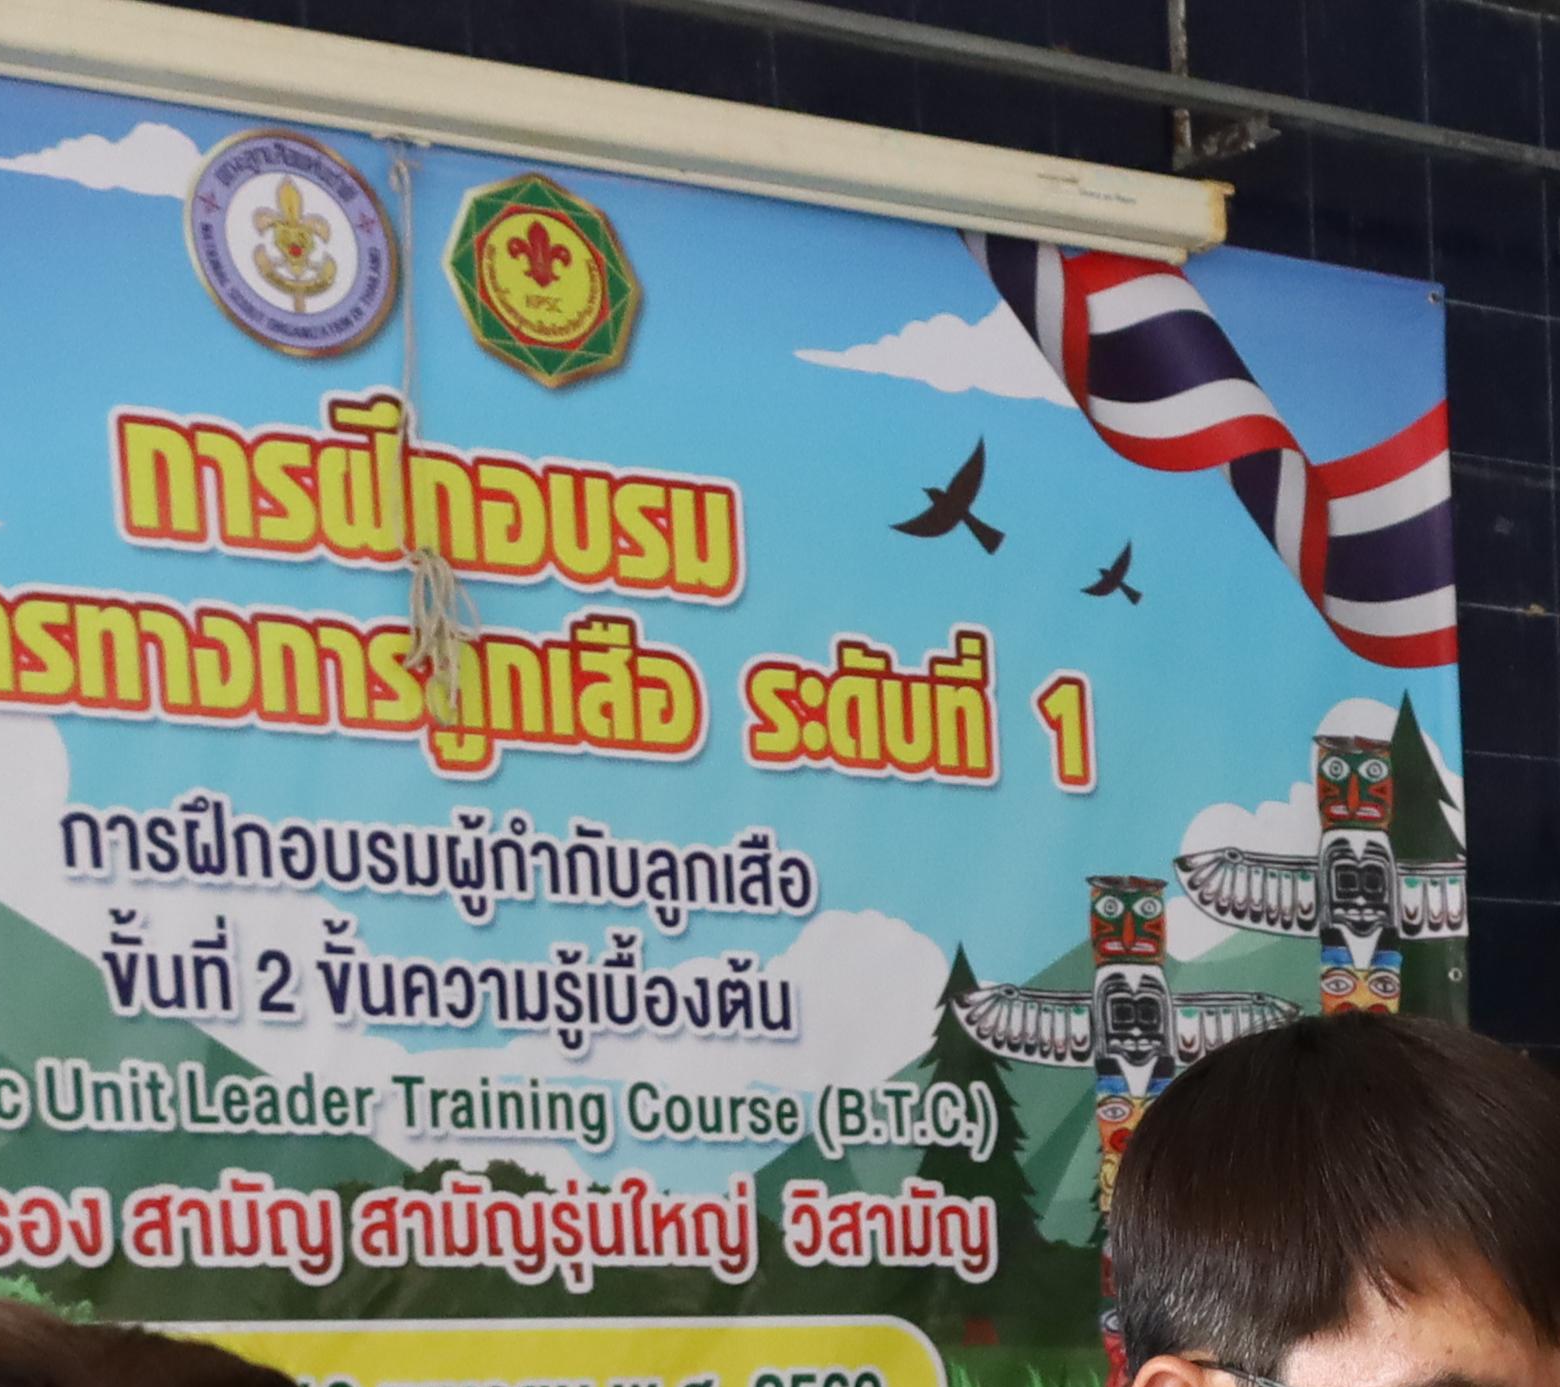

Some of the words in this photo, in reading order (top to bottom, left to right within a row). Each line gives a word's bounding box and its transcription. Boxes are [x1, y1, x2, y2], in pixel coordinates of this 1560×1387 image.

[117, 394, 737, 597] การฝึกอบรม
[745, 630, 996, 779] ระดับที่
[1037, 677, 1090, 785] 1
[60, 798, 814, 926] การฝึกอบรมผู้กำกับลูกเสือ
[104, 910, 232, 1012] ขั้นที่
[258, 951, 295, 1014] 2
[318, 920, 791, 1050] ขั้นความรู้เบื้องต้น
[45, 1066, 171, 1124] Unit
[186, 1070, 374, 1127] Leader
[392, 1075, 606, 1143] Training
[628, 1081, 799, 1135] Course
[819, 1083, 997, 1156] (B.T.C.)
[132, 1179, 333, 1275] สามัญ
[360, 1177, 751, 1283] สามัญรุ่นใหญ่
[790, 1186, 989, 1273] วิสามัญ
